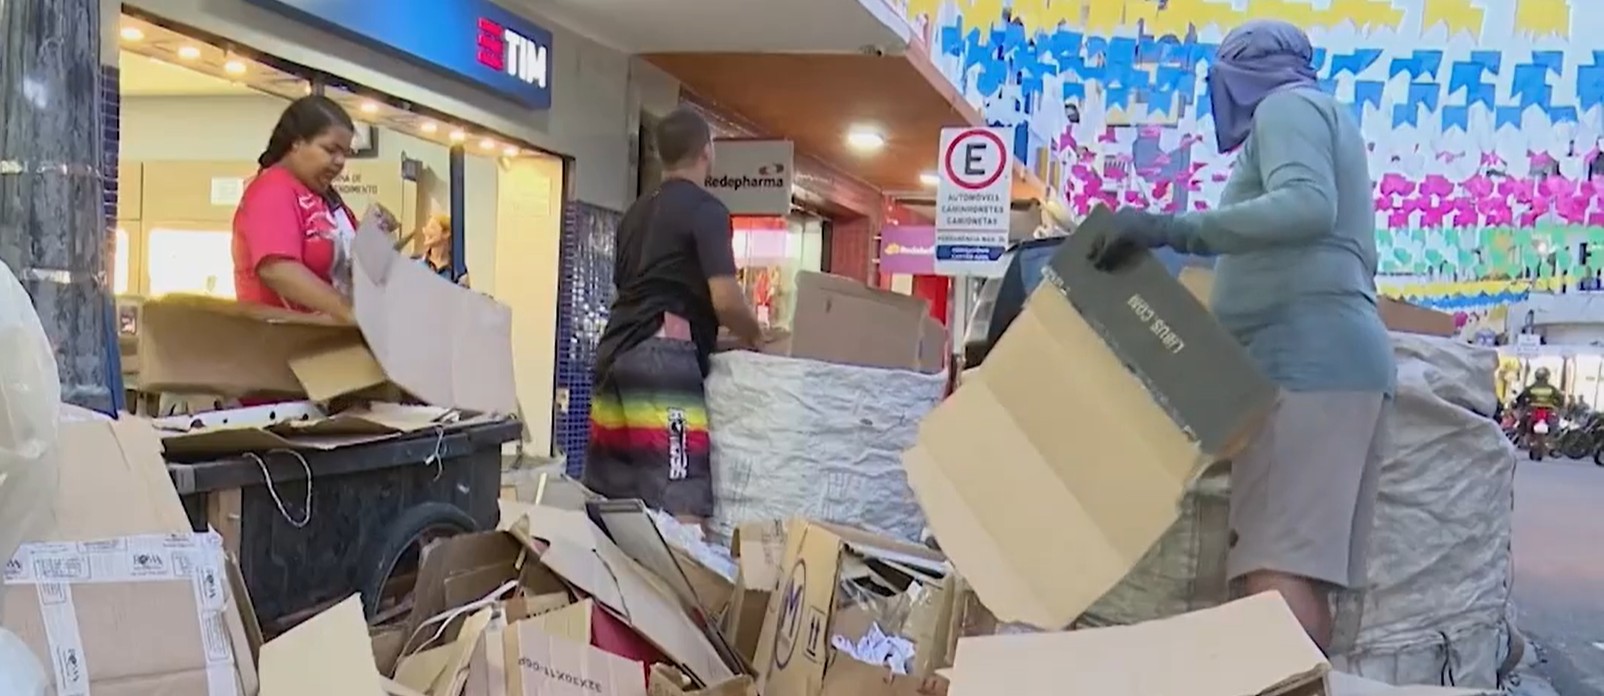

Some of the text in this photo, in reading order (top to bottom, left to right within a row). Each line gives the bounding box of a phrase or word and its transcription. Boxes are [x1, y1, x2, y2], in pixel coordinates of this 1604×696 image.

[505, 28, 547, 89] TIM
[965, 143, 987, 175] E
[704, 175, 783, 191] Redepharma
